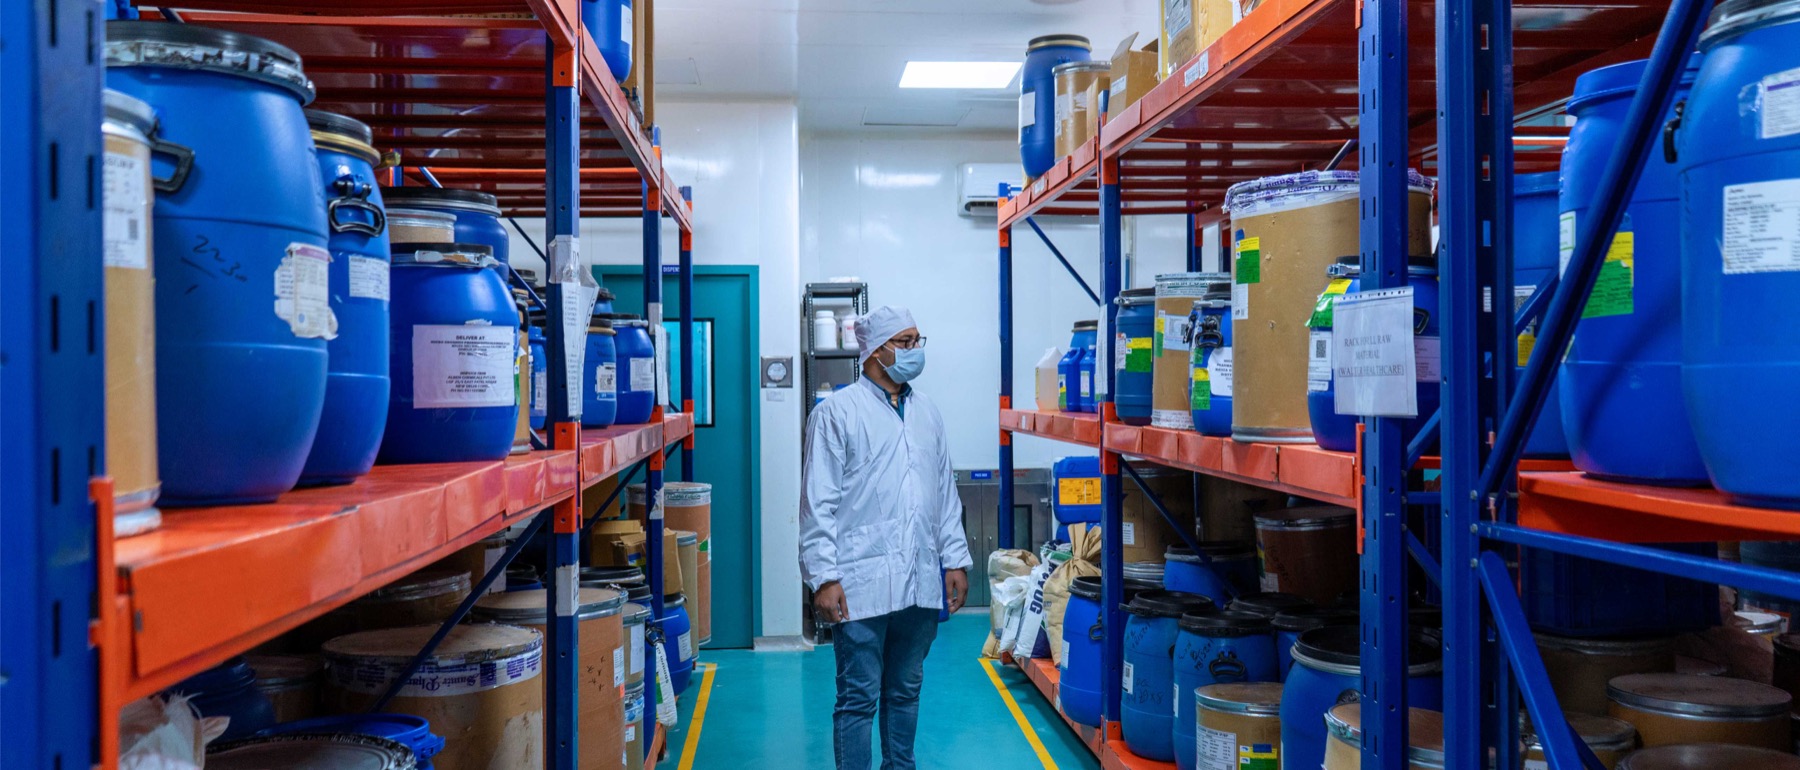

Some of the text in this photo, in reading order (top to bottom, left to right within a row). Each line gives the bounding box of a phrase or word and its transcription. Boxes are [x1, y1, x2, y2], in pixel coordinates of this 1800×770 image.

[1344, 337, 1360, 347] RACK
[1377, 333, 1392, 344] RAW
[1356, 349, 1380, 360] MATERIAL
